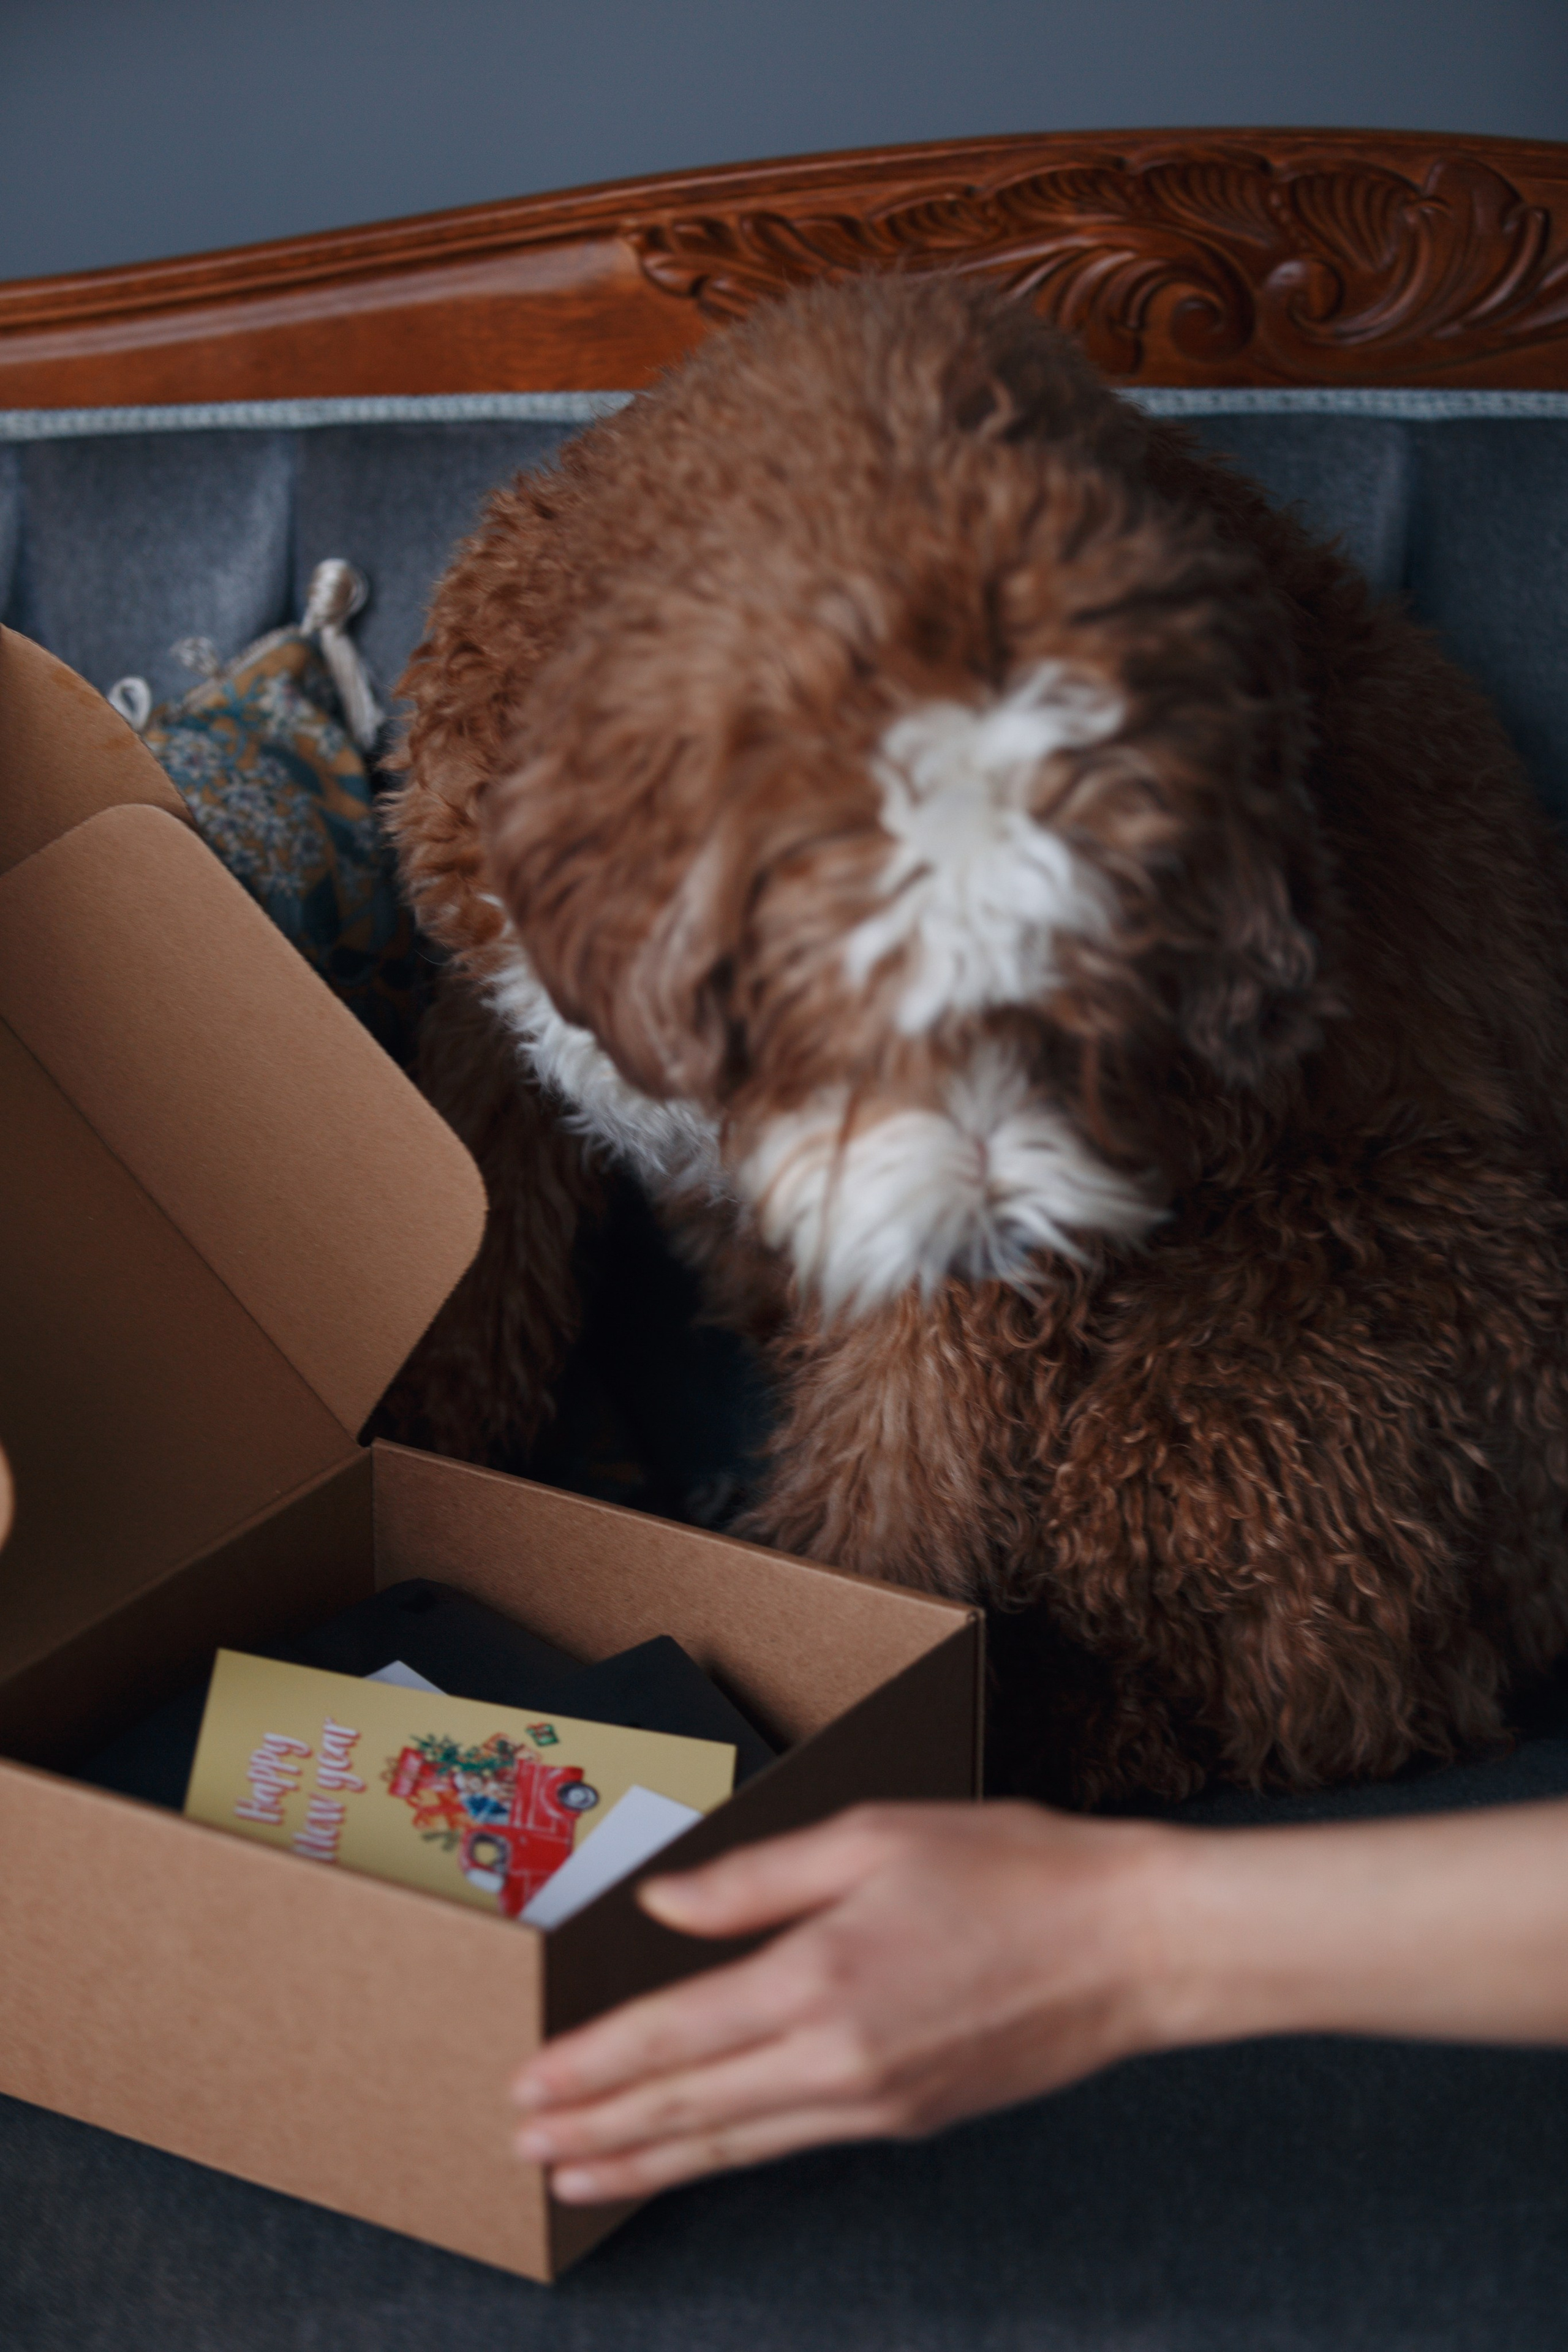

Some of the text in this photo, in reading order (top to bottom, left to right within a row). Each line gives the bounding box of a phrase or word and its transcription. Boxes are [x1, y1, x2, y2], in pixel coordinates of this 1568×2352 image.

[234, 1732, 313, 1826] Happy
[292, 1716, 368, 1864] New year
